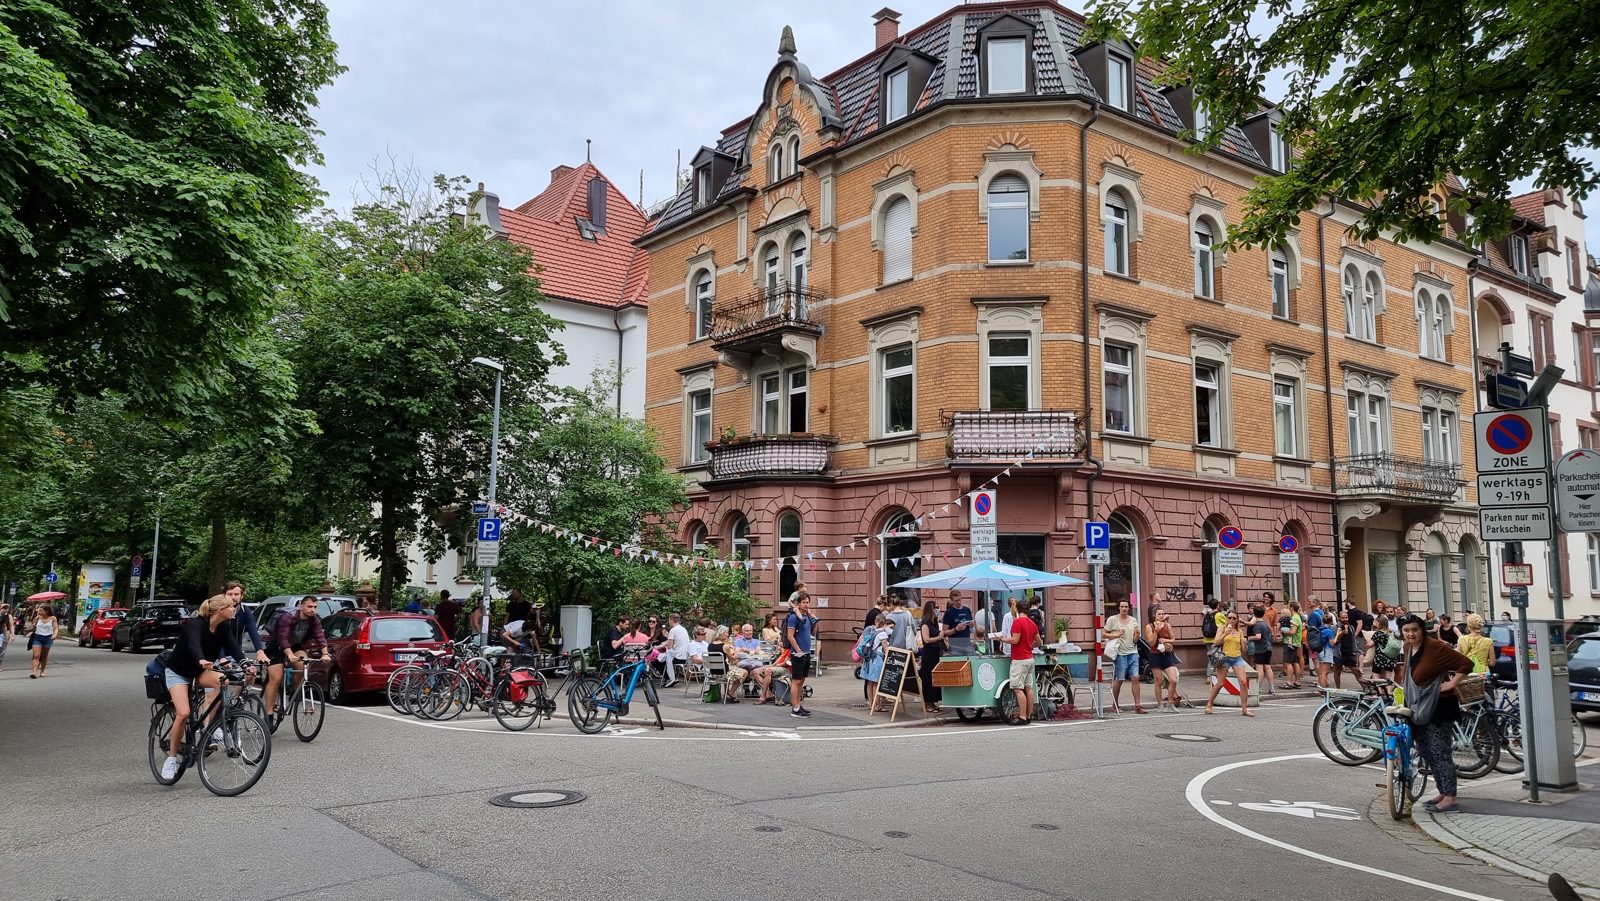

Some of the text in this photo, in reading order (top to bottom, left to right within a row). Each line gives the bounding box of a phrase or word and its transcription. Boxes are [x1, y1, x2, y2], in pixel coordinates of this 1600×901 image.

[1493, 456, 1529, 469] ZONE
[1482, 477, 1543, 491] werktags
[1567, 483, 1600, 492] automat
[1484, 512, 1546, 522] Parken nur mit
[1569, 511, 1600, 519] Parkschei
[483, 521, 495, 538] P
[1486, 524, 1532, 535] Parkschein
[1090, 526, 1104, 546] P
